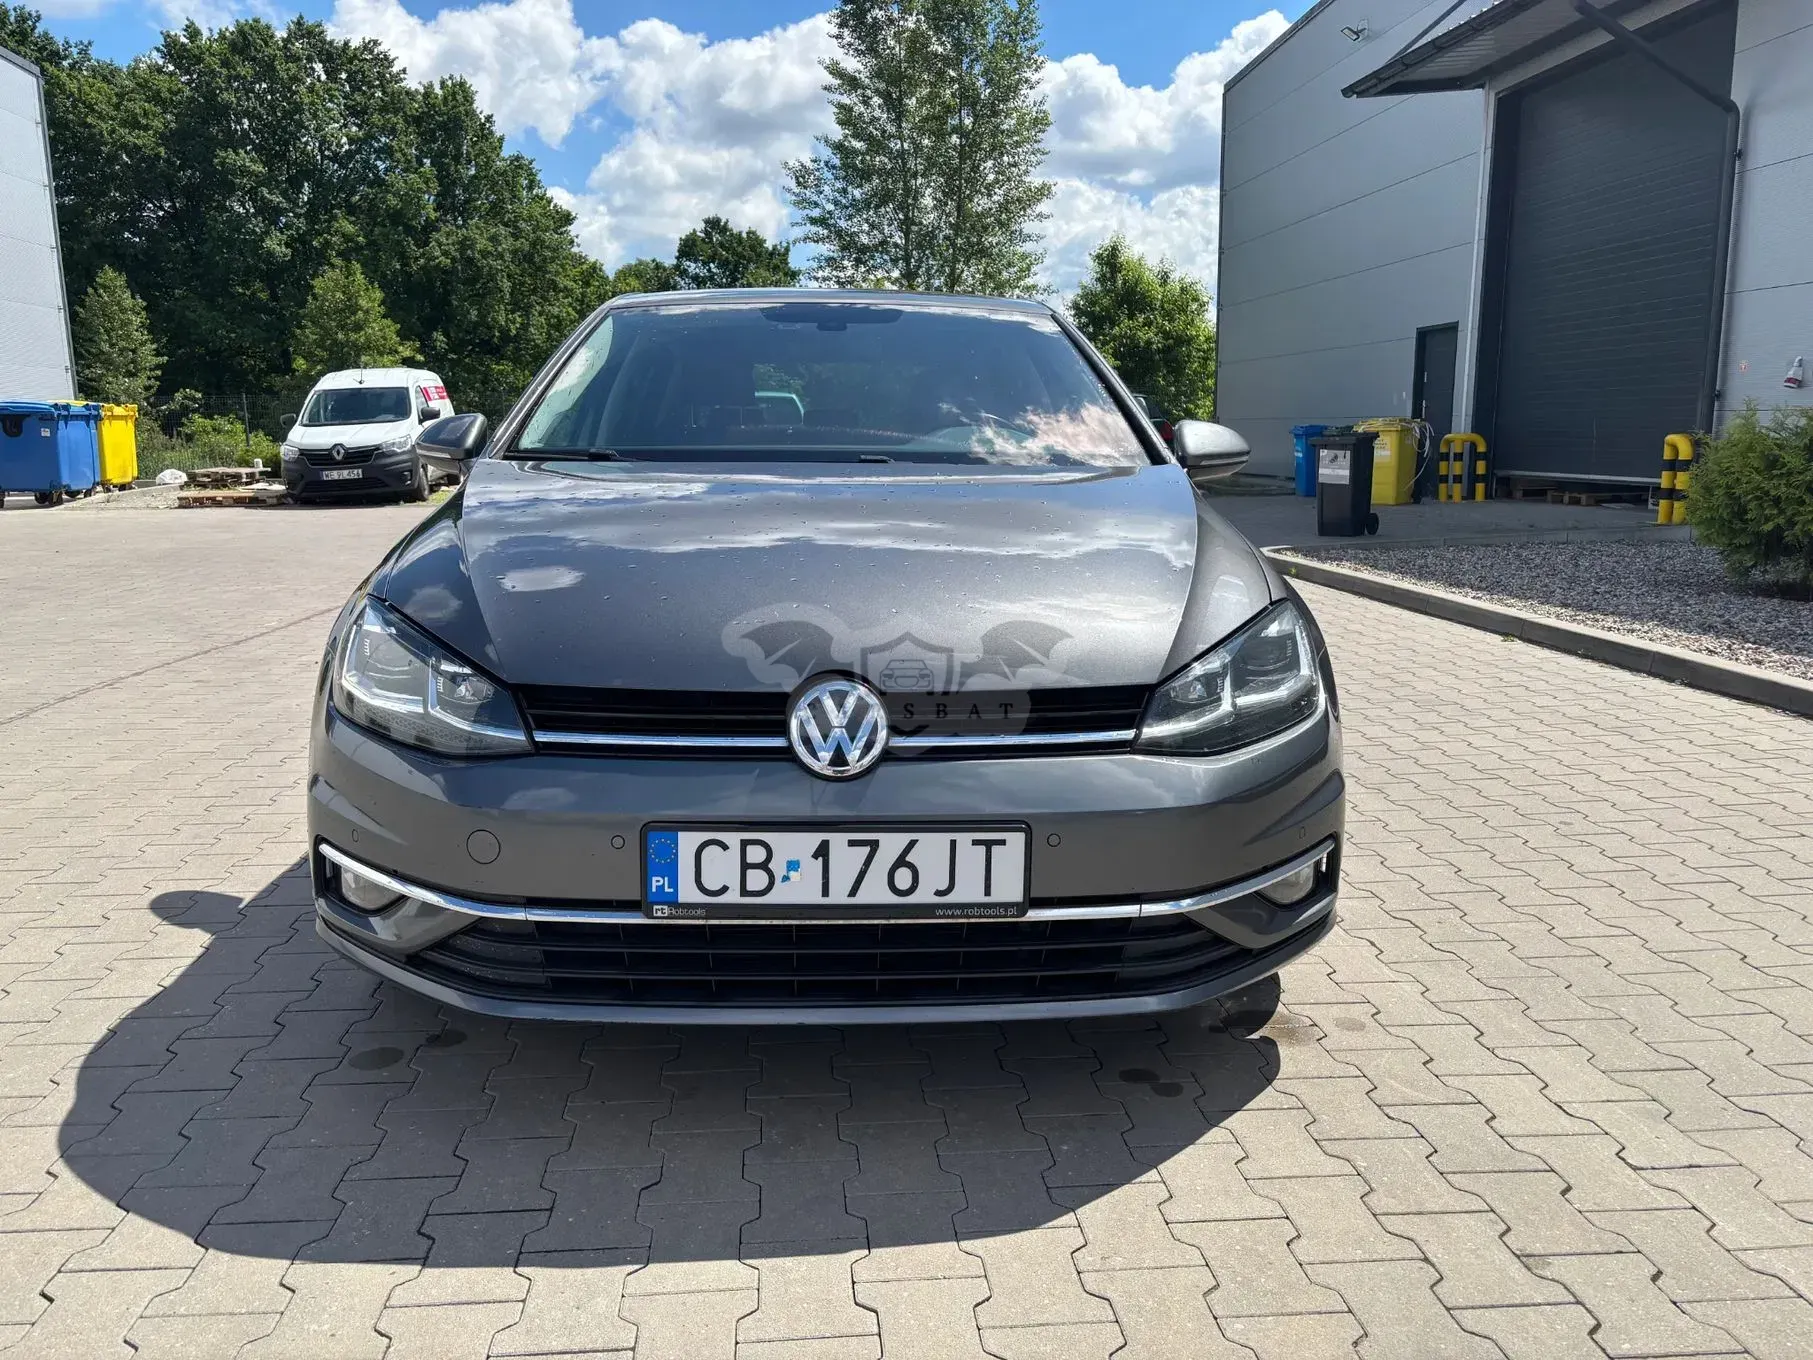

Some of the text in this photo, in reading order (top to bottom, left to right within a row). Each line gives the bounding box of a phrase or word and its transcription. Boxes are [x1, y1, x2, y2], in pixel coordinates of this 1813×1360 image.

[694, 838, 1008, 898] CB 176JT
[651, 876, 674, 893] PL
[935, 906, 1017, 917] www.robtools.pl
